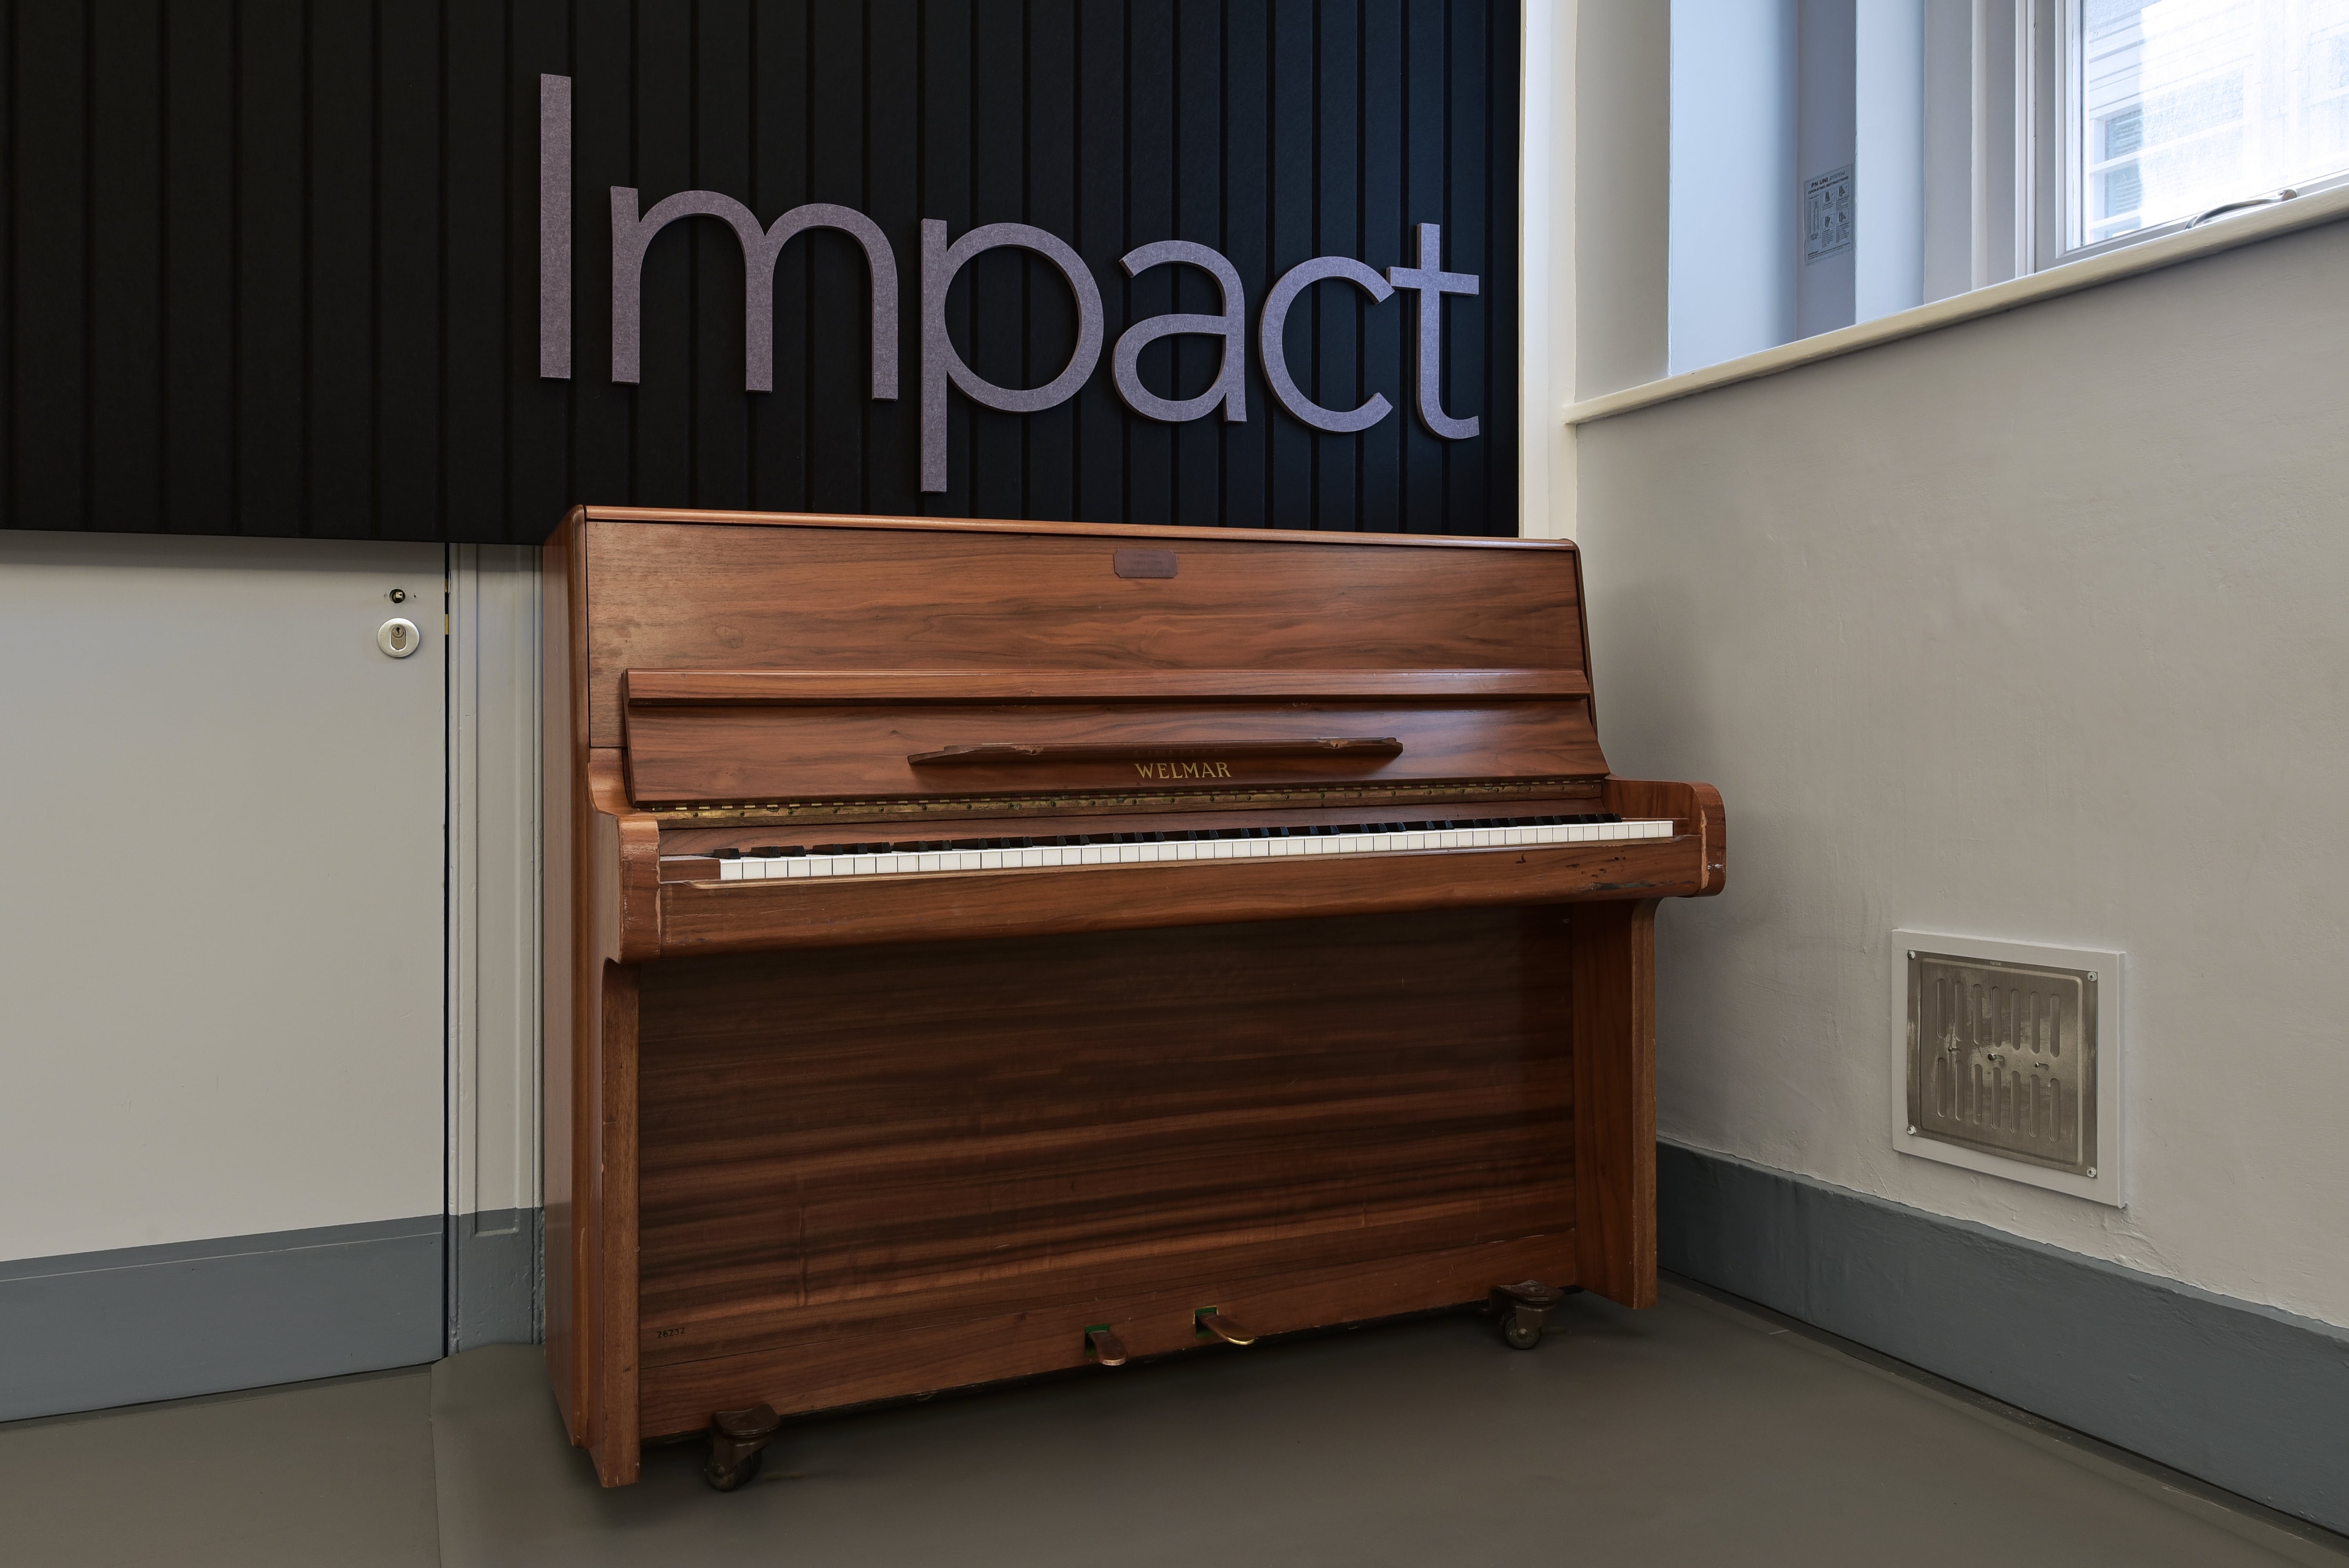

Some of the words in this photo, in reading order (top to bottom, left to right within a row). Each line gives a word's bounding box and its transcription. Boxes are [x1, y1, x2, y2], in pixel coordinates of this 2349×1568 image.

[1829, 171, 1845, 181] SYSTEM
[540, 73, 1480, 492] Impact
[1134, 762, 1232, 779] WELMAR
[657, 1327, 685, 1338] 26232
